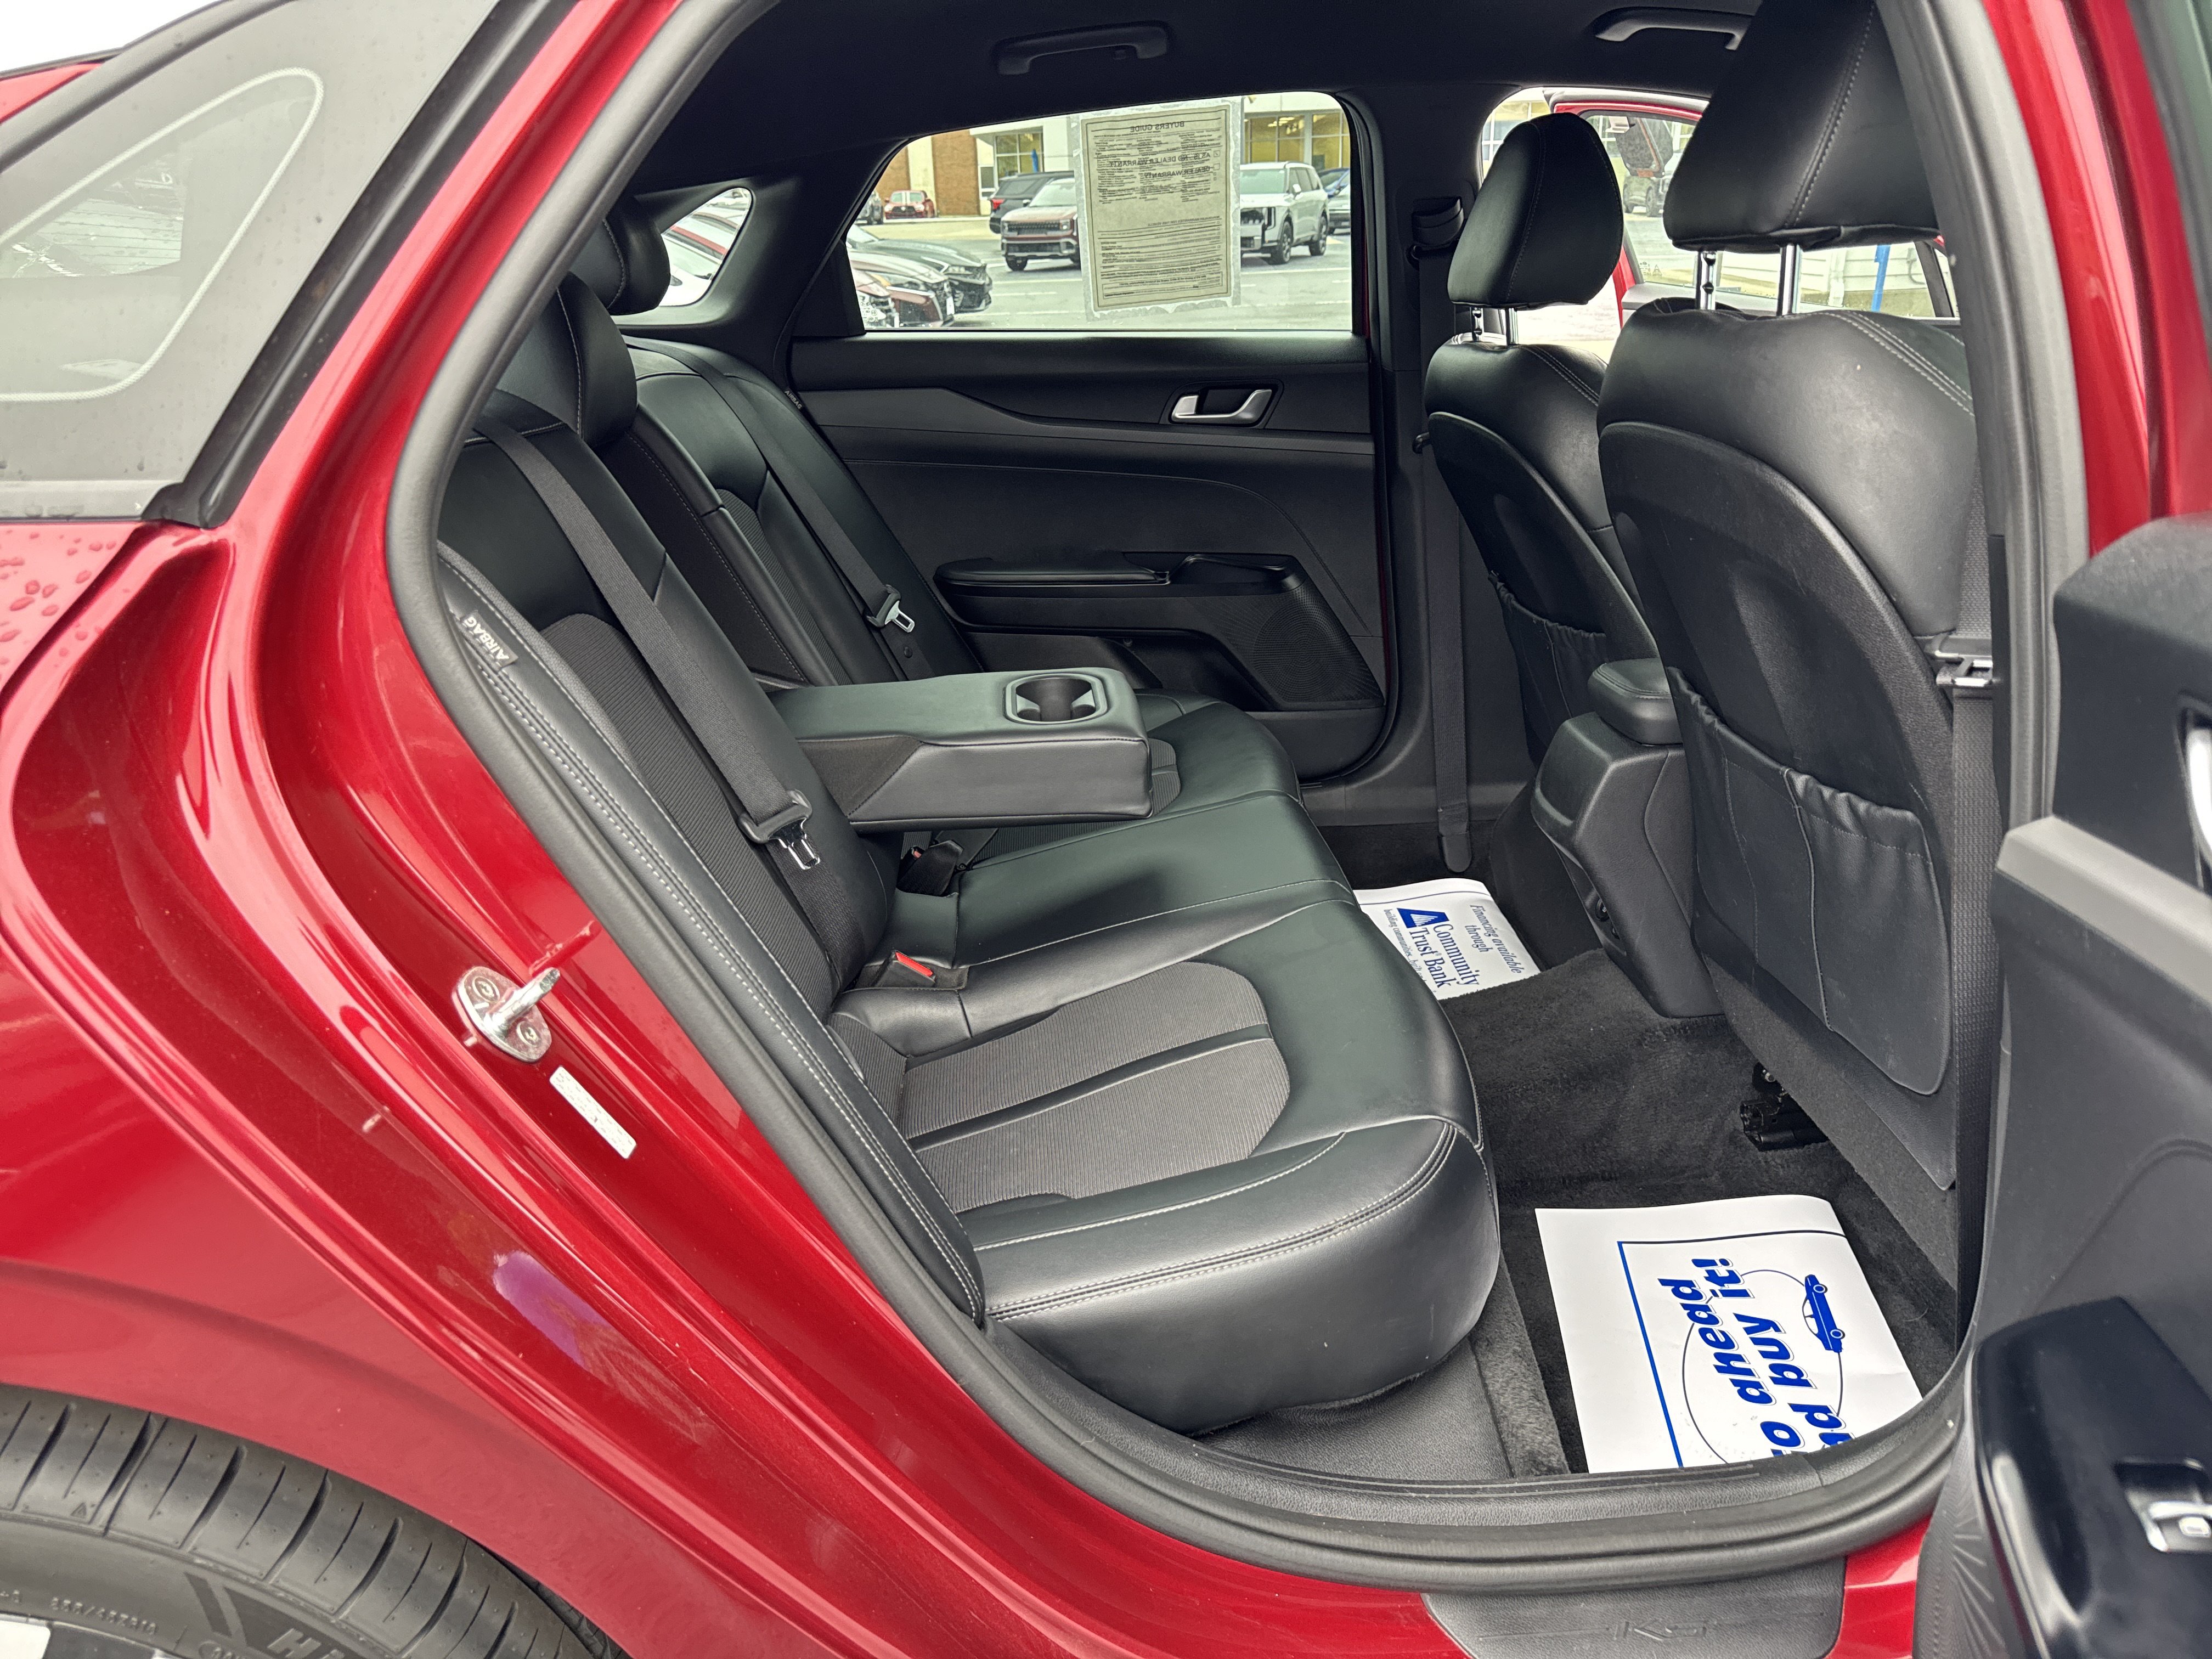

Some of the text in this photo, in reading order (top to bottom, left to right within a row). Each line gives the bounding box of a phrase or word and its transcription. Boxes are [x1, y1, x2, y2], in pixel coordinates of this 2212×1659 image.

[464, 616, 510, 659] AIRBAG
[1384, 909, 1398, 928] building
[1464, 924, 1489, 953] through
[1469, 904, 1522, 974] Financing available
[1409, 927, 1457, 989] Trust Bank
[1432, 923, 1480, 986] Community
[1691, 1257, 1756, 1300] it!
[1657, 1278, 1809, 1457] o ahead
[1733, 1312, 1817, 1390] buy
